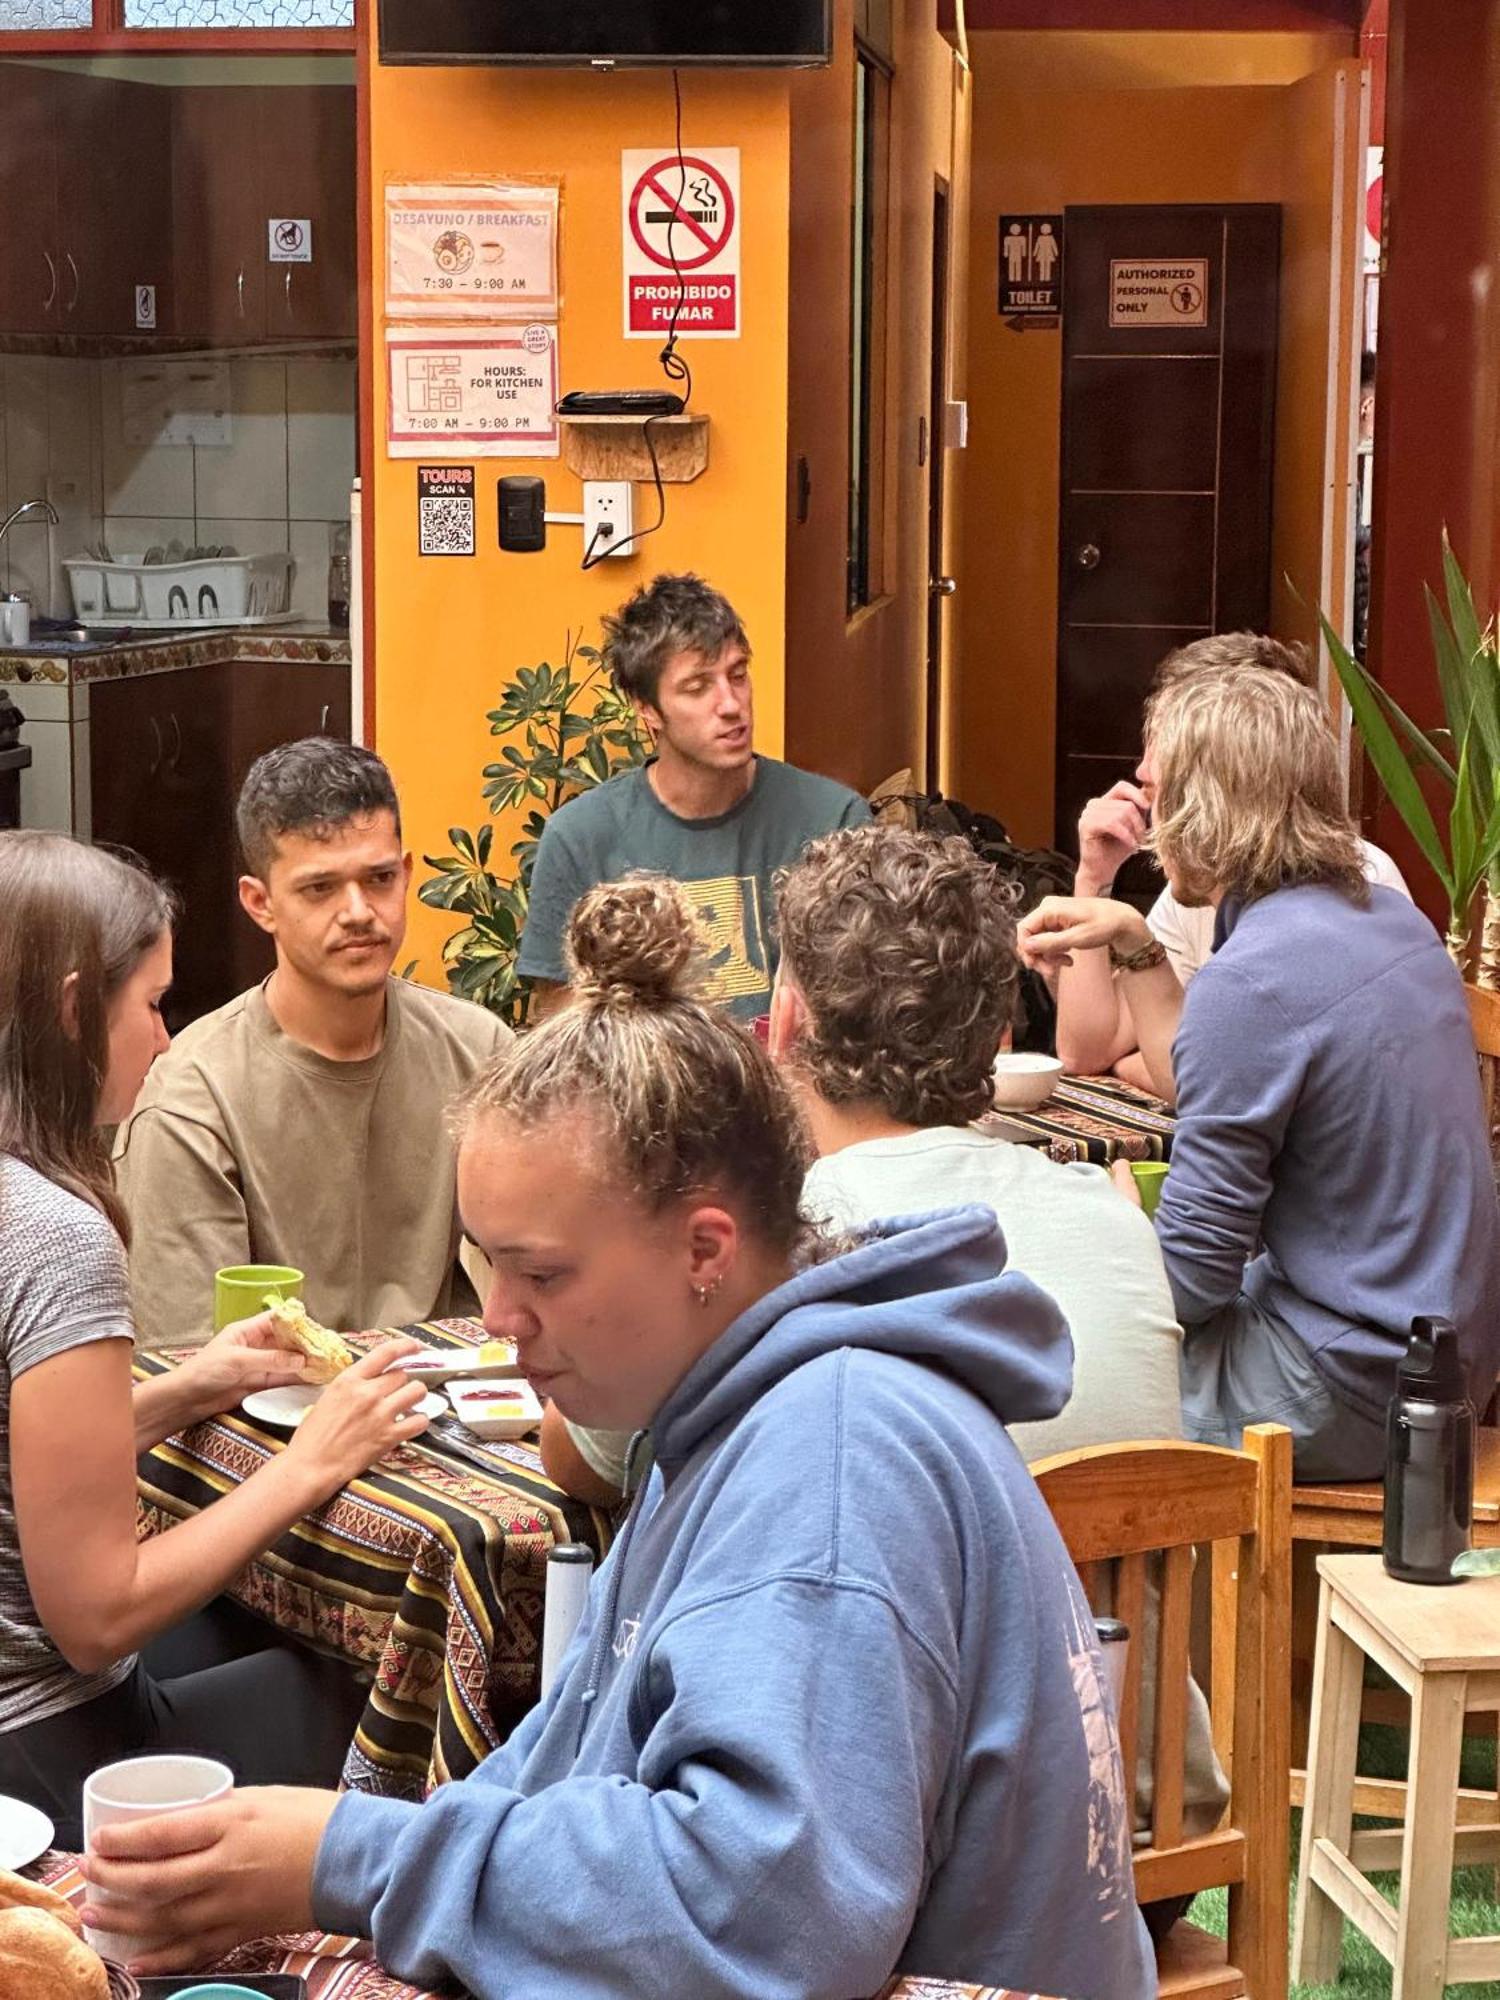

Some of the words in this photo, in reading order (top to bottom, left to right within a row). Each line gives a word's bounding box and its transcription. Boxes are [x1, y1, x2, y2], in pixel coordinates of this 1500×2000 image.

[393, 212, 465, 225] DESAYUNO
[467, 213, 475, 225] /
[476, 213, 549, 225] BREAKFAST
[1116, 268, 1195, 279] AUTHORIZED
[423, 277, 453, 289] 7:30
[474, 277, 504, 289] 9:00
[511, 278, 526, 289] AM
[633, 285, 731, 300] PROHIBIDO
[1116, 287, 1169, 296] PERSONAL
[1007, 291, 1053, 305] TOILET
[651, 306, 714, 320] FUMAR
[1116, 303, 1148, 313] ONLY
[484, 366, 526, 377] HOURS:
[470, 378, 492, 388] FOR
[495, 378, 543, 388] KITCHEN
[497, 390, 517, 399] USE
[408, 418, 438, 429] 7:00
[445, 418, 459, 428] AM
[479, 418, 509, 429] 9:00
[515, 418, 530, 428] PM
[420, 469, 473, 483] TOURS
[429, 485, 455, 494] SCAN
